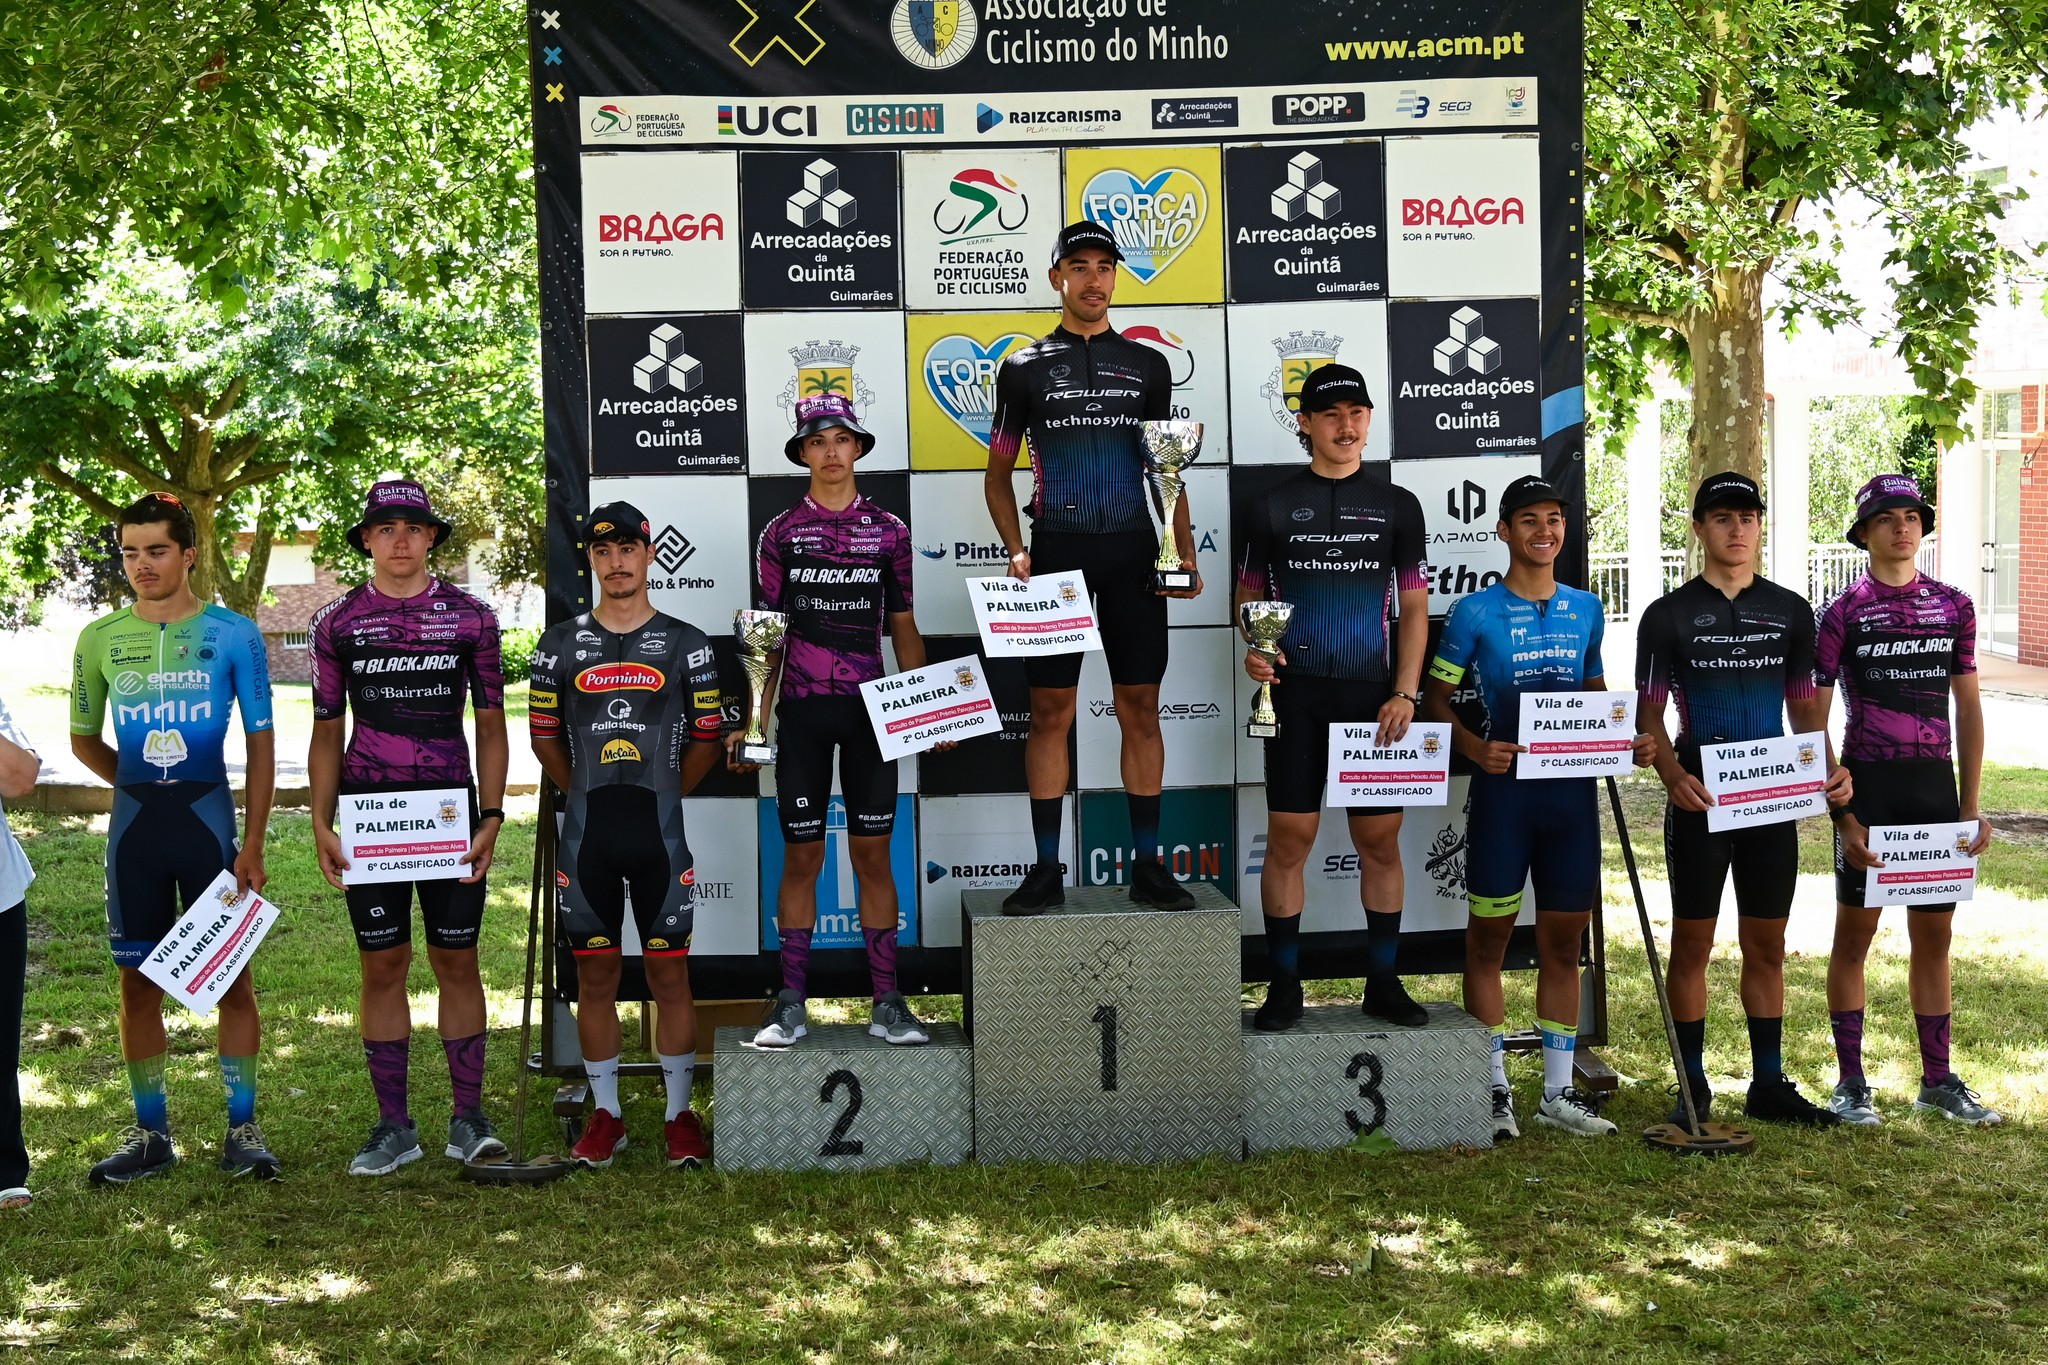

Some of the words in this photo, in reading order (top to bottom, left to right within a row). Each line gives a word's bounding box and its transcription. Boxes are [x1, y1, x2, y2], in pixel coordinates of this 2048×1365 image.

[986, 29, 1096, 64] Ciclismo
[1106, 27, 1138, 62] do
[1148, 24, 1229, 60] Minho
[1325, 31, 1524, 61] www.acm.pt
[1179, 102, 1232, 111] Arrecadações
[636, 113, 679, 123] FEDERAÇÃO
[736, 105, 817, 137] UCI
[851, 105, 937, 134] CISION
[1185, 112, 1211, 120] Quintã
[637, 122, 685, 130] PORTUGUESA
[637, 130, 647, 138] DE
[1089, 193, 1197, 223] FORÇA
[1402, 196, 1524, 228] BRAGA
[599, 212, 723, 244] BRAGA
[1236, 222, 1377, 245] Arrecadações
[750, 231, 892, 253] Arrecadações
[1402, 233, 1422, 241] SOA
[599, 249, 619, 257] SOA
[815, 253, 828, 262] da
[1300, 246, 1313, 255] da
[939, 249, 1024, 267] FEDERAÇÃO
[1274, 256, 1341, 276] Quintã
[787, 264, 855, 283] Quintã
[934, 268, 1029, 280] PORTUGUESA
[937, 282, 956, 294] DE
[961, 282, 1027, 294] CICLISMO
[1316, 281, 1380, 294] Guimarães
[830, 290, 893, 301] Guimarães
[1316, 380, 1360, 393] ROWER
[1399, 377, 1535, 400] Arrecadações
[1045, 389, 1140, 401] ROWER
[598, 394, 738, 417] Arrecadações
[1461, 401, 1474, 410] da
[662, 418, 675, 428] da
[1046, 414, 1139, 429] technosylva
[1435, 410, 1500, 431] Quintã
[636, 428, 702, 448] Quintã
[1476, 436, 1537, 449] Guimarães
[677, 454, 740, 466] Guimarães
[375, 486, 424, 498] Bairrada
[1710, 481, 1754, 492] ROWER
[378, 493, 406, 503] Cycling
[1289, 533, 1379, 543] ROWER
[1288, 558, 1380, 572] technosylva
[801, 568, 881, 583] BLACKJACK
[666, 579, 676, 589] &
[679, 577, 714, 589] Pinho
[981, 582, 1008, 592] Vila
[1012, 583, 1028, 593] de
[811, 597, 870, 611] Bairrada
[986, 600, 1060, 612] PALMEIRA
[1058, 621, 1076, 629] Peixoto
[1016, 634, 1085, 646] CLASSIFICADO
[1693, 632, 1781, 643] ROWER
[1512, 645, 1577, 662] moreira
[1872, 638, 1955, 657] BLACKJACK
[366, 654, 459, 674] BLACKJACK
[687, 645, 715, 669] BH
[1691, 655, 1784, 669] technosylva
[147, 669, 210, 684] earth
[1514, 665, 1574, 677] BOLFLEX
[1886, 665, 1947, 681] Bairrada
[147, 681, 210, 690] consulters
[586, 672, 656, 687] Porminho
[875, 681, 904, 693] Vila
[908, 675, 925, 686] de
[380, 683, 452, 699] Bairrada
[881, 686, 958, 712] PALMEIRA
[1535, 698, 1562, 709] Vila
[1566, 698, 1583, 708] de
[591, 720, 646, 734] Fallasleep
[914, 716, 984, 740] CLASSIFICADO
[1533, 719, 1607, 731] PALMEIRA
[1344, 728, 1371, 739] Vila
[603, 747, 637, 761] McCain
[1581, 743, 1598, 751] Prémio
[1716, 749, 1745, 760] Vila
[1750, 745, 1768, 756] de
[1343, 750, 1418, 760] PALMEIRA
[1551, 756, 1619, 767] CLASSIFICADO
[1368, 773, 1390, 781] Palmeira
[1718, 763, 1795, 783] PALMEIRA
[1362, 787, 1433, 796] CLASSIFICADO
[1720, 795, 1739, 803] Circuito
[1747, 792, 1768, 800] Palmeira
[1789, 786, 1808, 795] Peixoto
[354, 799, 384, 811] Vila
[389, 798, 408, 809] de
[1743, 798, 1813, 816] CLASSIFICADO
[355, 819, 437, 834] PALMEIRA
[1883, 831, 1909, 841] Vila
[1913, 830, 1930, 840] de
[357, 847, 376, 855] Circuito
[385, 846, 408, 854] Palmeira
[411, 845, 429, 853] Prémio
[1881, 849, 1951, 862] PALMEIRA
[380, 858, 455, 871] CLASSIFICADO
[1090, 843, 1220, 885] CIION
[1436, 886, 1457, 900] Flor
[1898, 884, 1962, 896] CLASSIFICADO
[152, 939, 180, 964] Vila
[179, 920, 195, 937] de
[170, 913, 232, 979] PALMEIRA
[216, 917, 263, 982] CLASSIFICADO
[1092, 1005, 1117, 1091] 1
[1345, 1053, 1386, 1135] 3
[818, 1069, 864, 1156] 2
